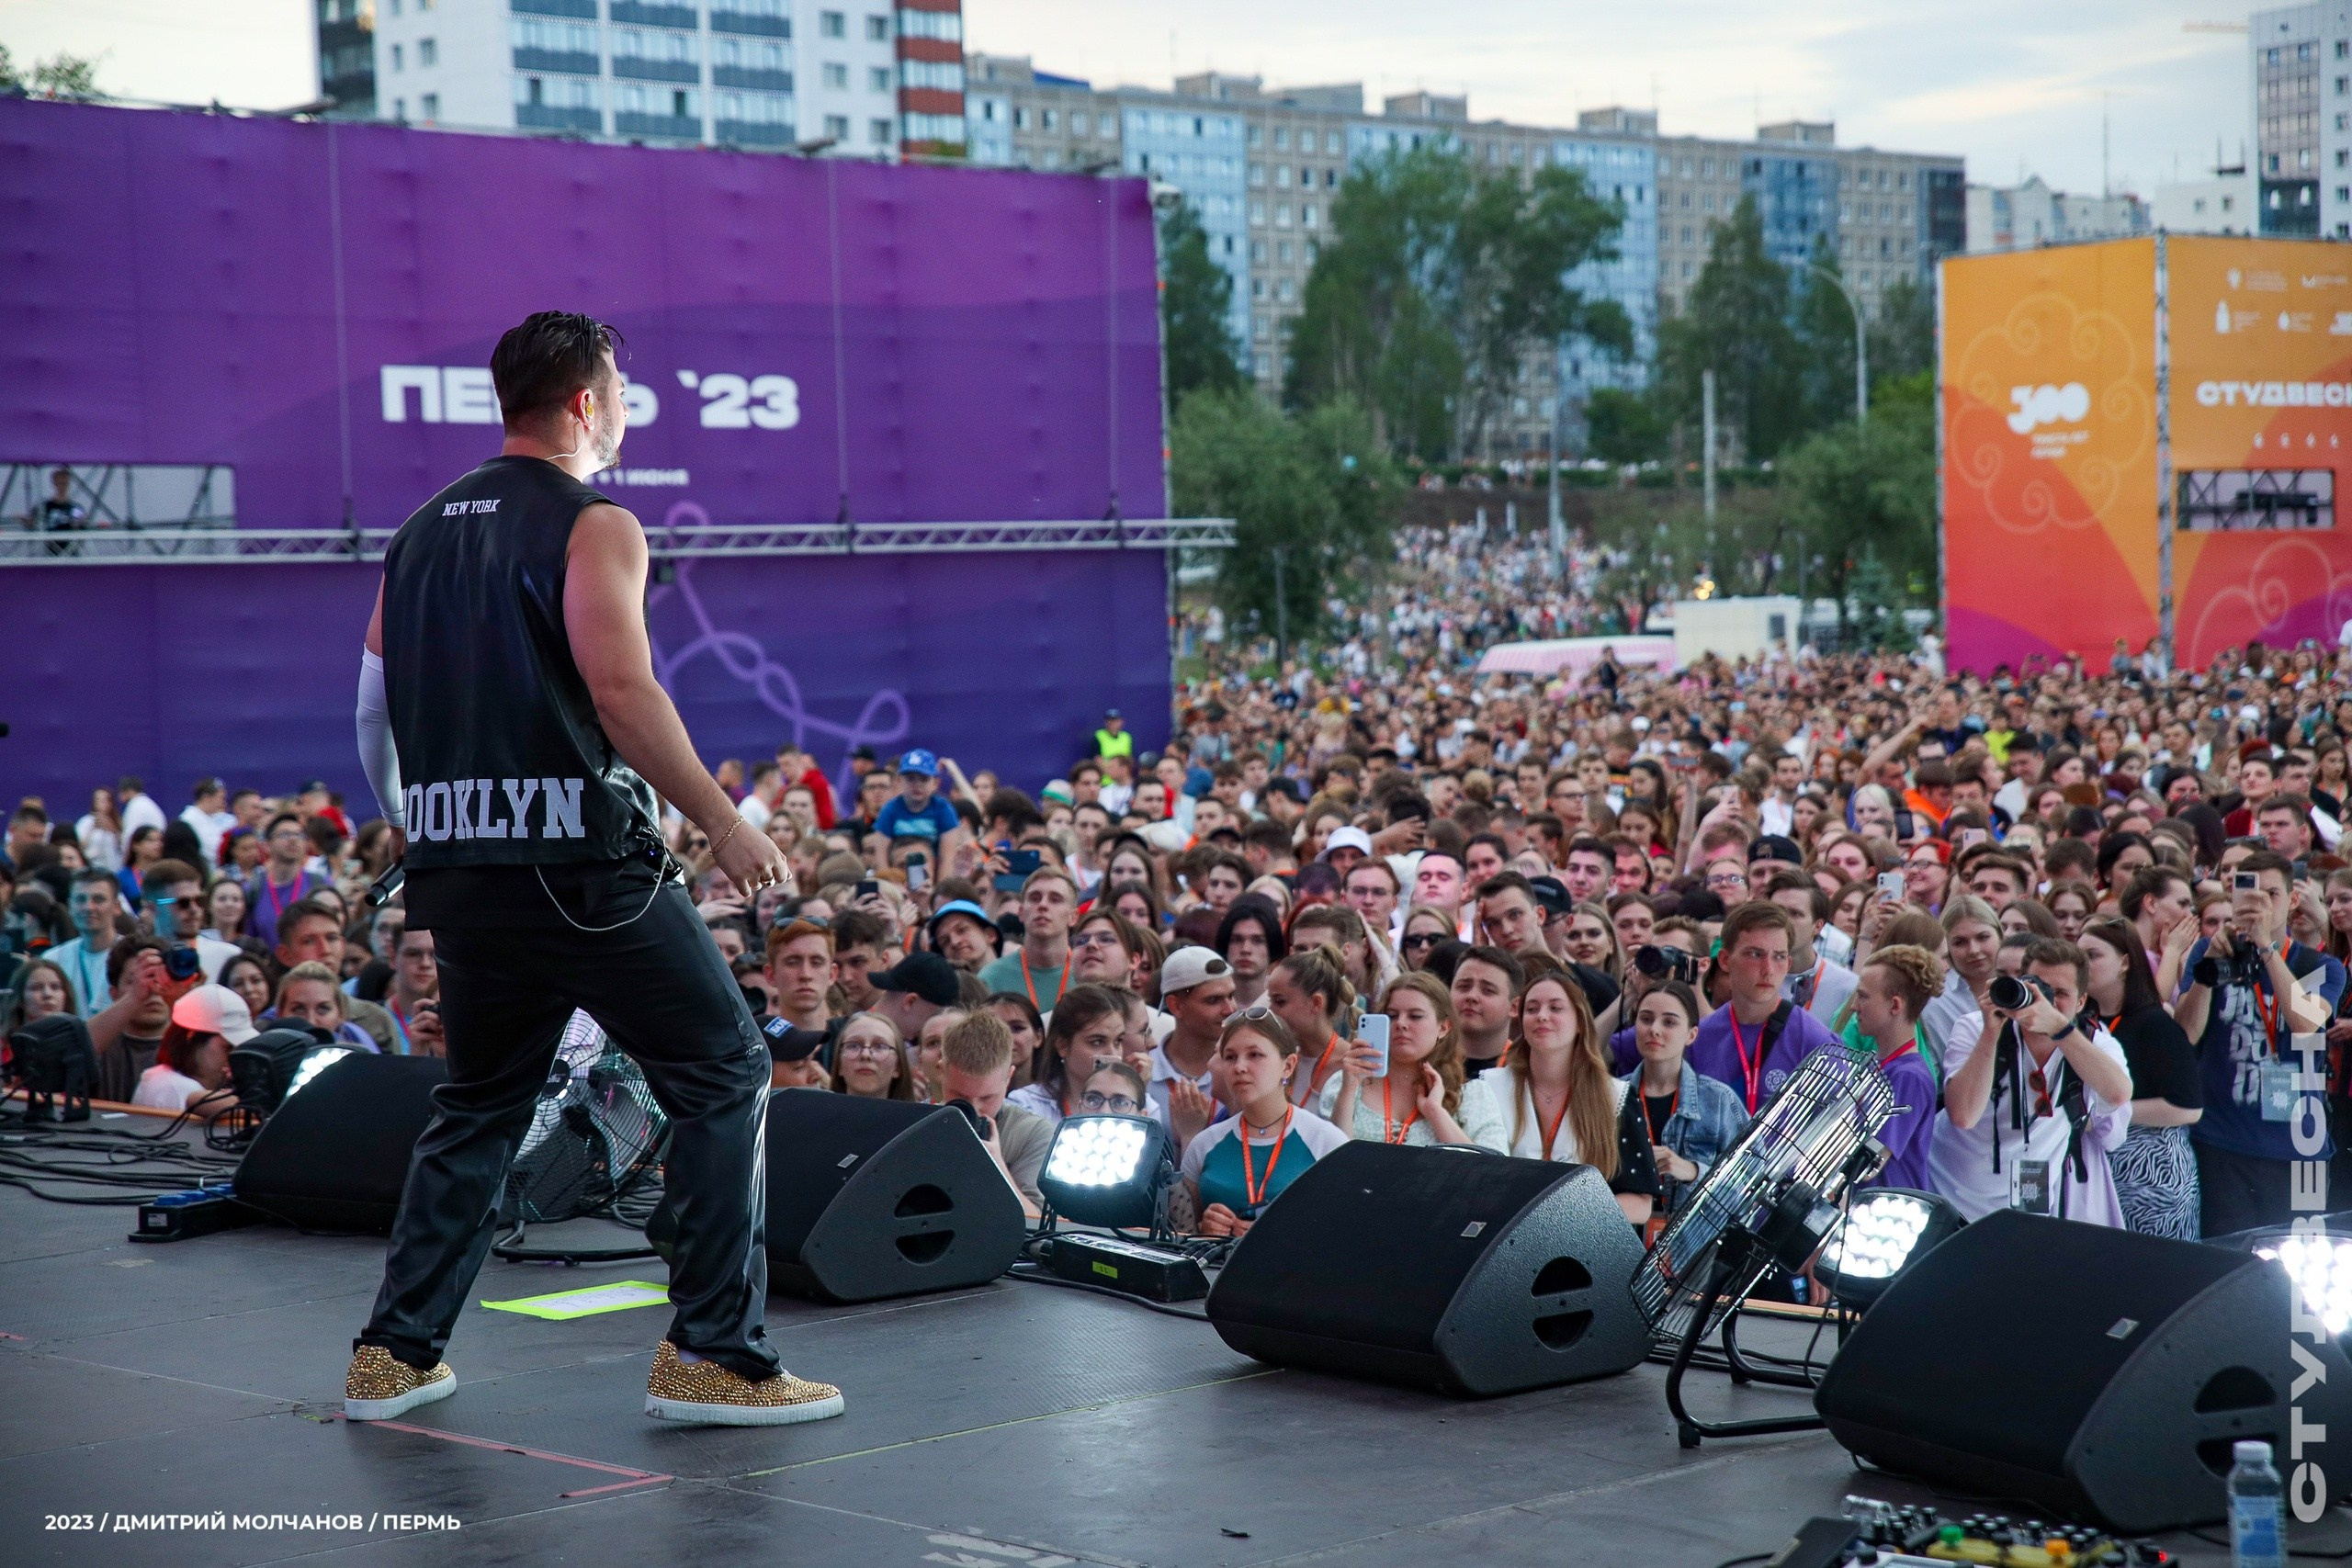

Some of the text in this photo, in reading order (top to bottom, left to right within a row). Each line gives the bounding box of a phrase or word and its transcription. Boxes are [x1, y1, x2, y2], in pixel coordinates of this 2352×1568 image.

[380, 365, 659, 428] ПЕЬ
[442, 499, 501, 516] NEW YORK
[402, 778, 585, 842] OOKLYN
